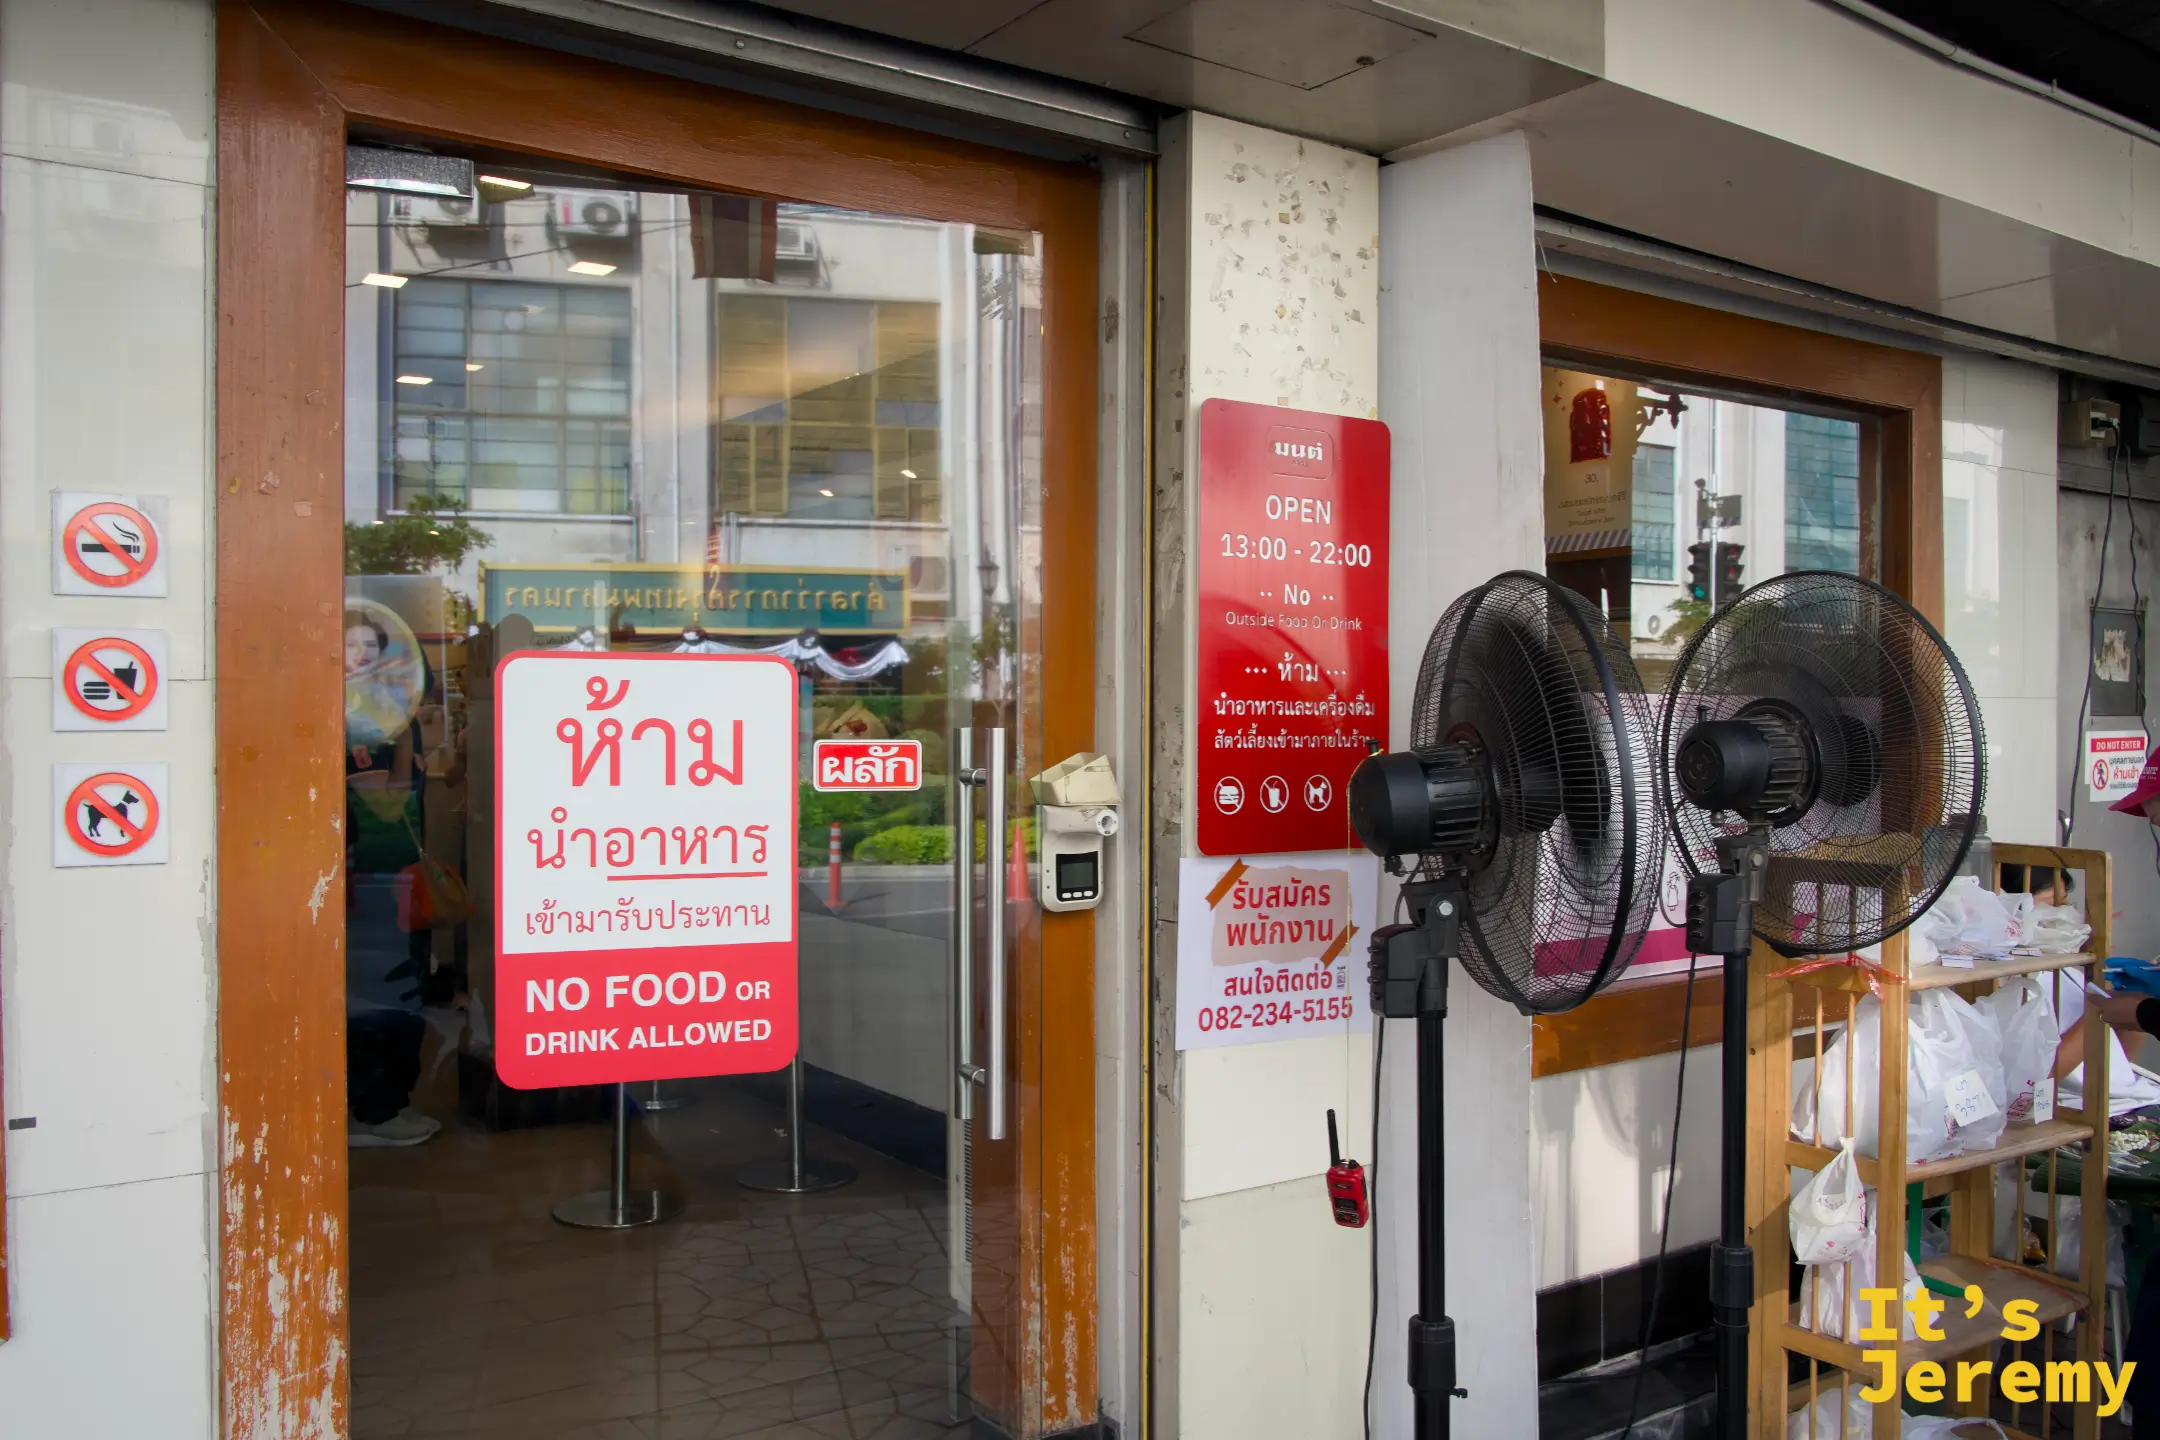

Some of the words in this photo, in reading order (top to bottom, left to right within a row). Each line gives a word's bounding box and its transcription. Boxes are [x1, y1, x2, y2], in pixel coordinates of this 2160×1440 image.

[1265, 494, 1332, 525] OPEN
[1220, 533, 1287, 561] 13:00
[1309, 540, 1372, 568] 22:00
[1283, 583, 1311, 606] No
[1225, 611, 1275, 628] Outside
[1278, 613, 1308, 629] Food
[1311, 614, 1328, 629] Or
[1330, 616, 1363, 631] Drink
[1277, 651, 1319, 682] ห้าม
[1213, 688, 1376, 717] นำอาหารและเครื่องดื่ม
[554, 674, 744, 787] ห้าม
[2096, 742, 2106, 750] DO
[2107, 741, 2119, 750] NOT
[2121, 740, 2141, 749] ENTER
[820, 745, 915, 784] ผลัก
[526, 806, 770, 869] นำอาหาร
[1231, 876, 1332, 910] รับสมัคร
[525, 896, 771, 935] เข้ามารับประทาน
[1226, 912, 1334, 947] พนักงาน
[525, 976, 591, 1014] NO
[604, 970, 727, 1009] FOOD
[735, 979, 771, 1002] OR
[1223, 962, 1333, 997] สนใจติดต่อ
[1198, 996, 1353, 1032] 082-234-5155
[524, 1027, 620, 1057] DRINK
[627, 1017, 772, 1051] ALLOWED
